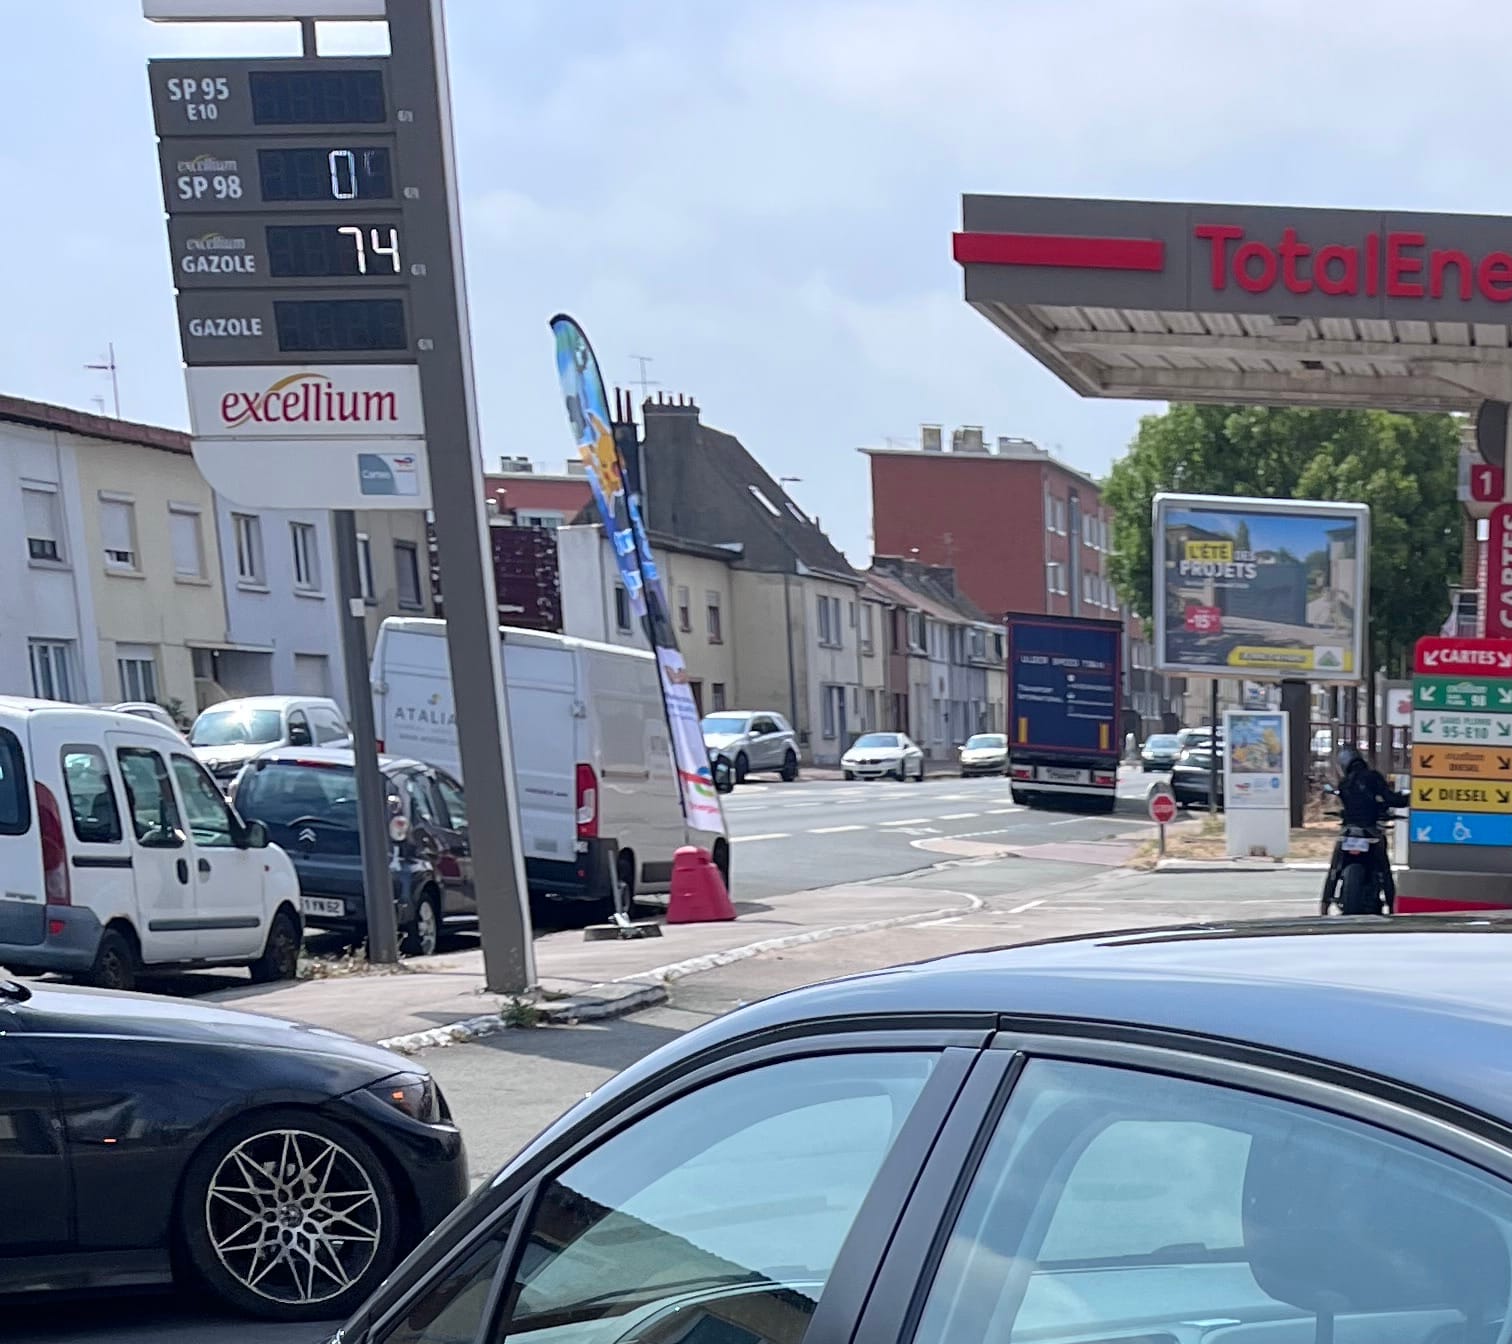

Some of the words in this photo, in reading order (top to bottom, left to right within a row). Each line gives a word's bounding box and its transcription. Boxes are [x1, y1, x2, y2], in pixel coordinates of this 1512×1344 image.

[168, 78, 197, 100] SP
[201, 77, 230, 100] 95
[187, 104, 218, 121] E10
[177, 176, 208, 200] SP
[213, 175, 243, 200] 98
[338, 226, 400, 274] 74
[181, 255, 256, 273] GAZOLE
[189, 318, 262, 336] GAZOLE
[221, 382, 398, 422] excellium
[1479, 471, 1493, 496] 1
[1179, 559, 1258, 579] PROJETS
[1440, 649, 1497, 665] CARTES
[1439, 788, 1489, 803] DIESEL
